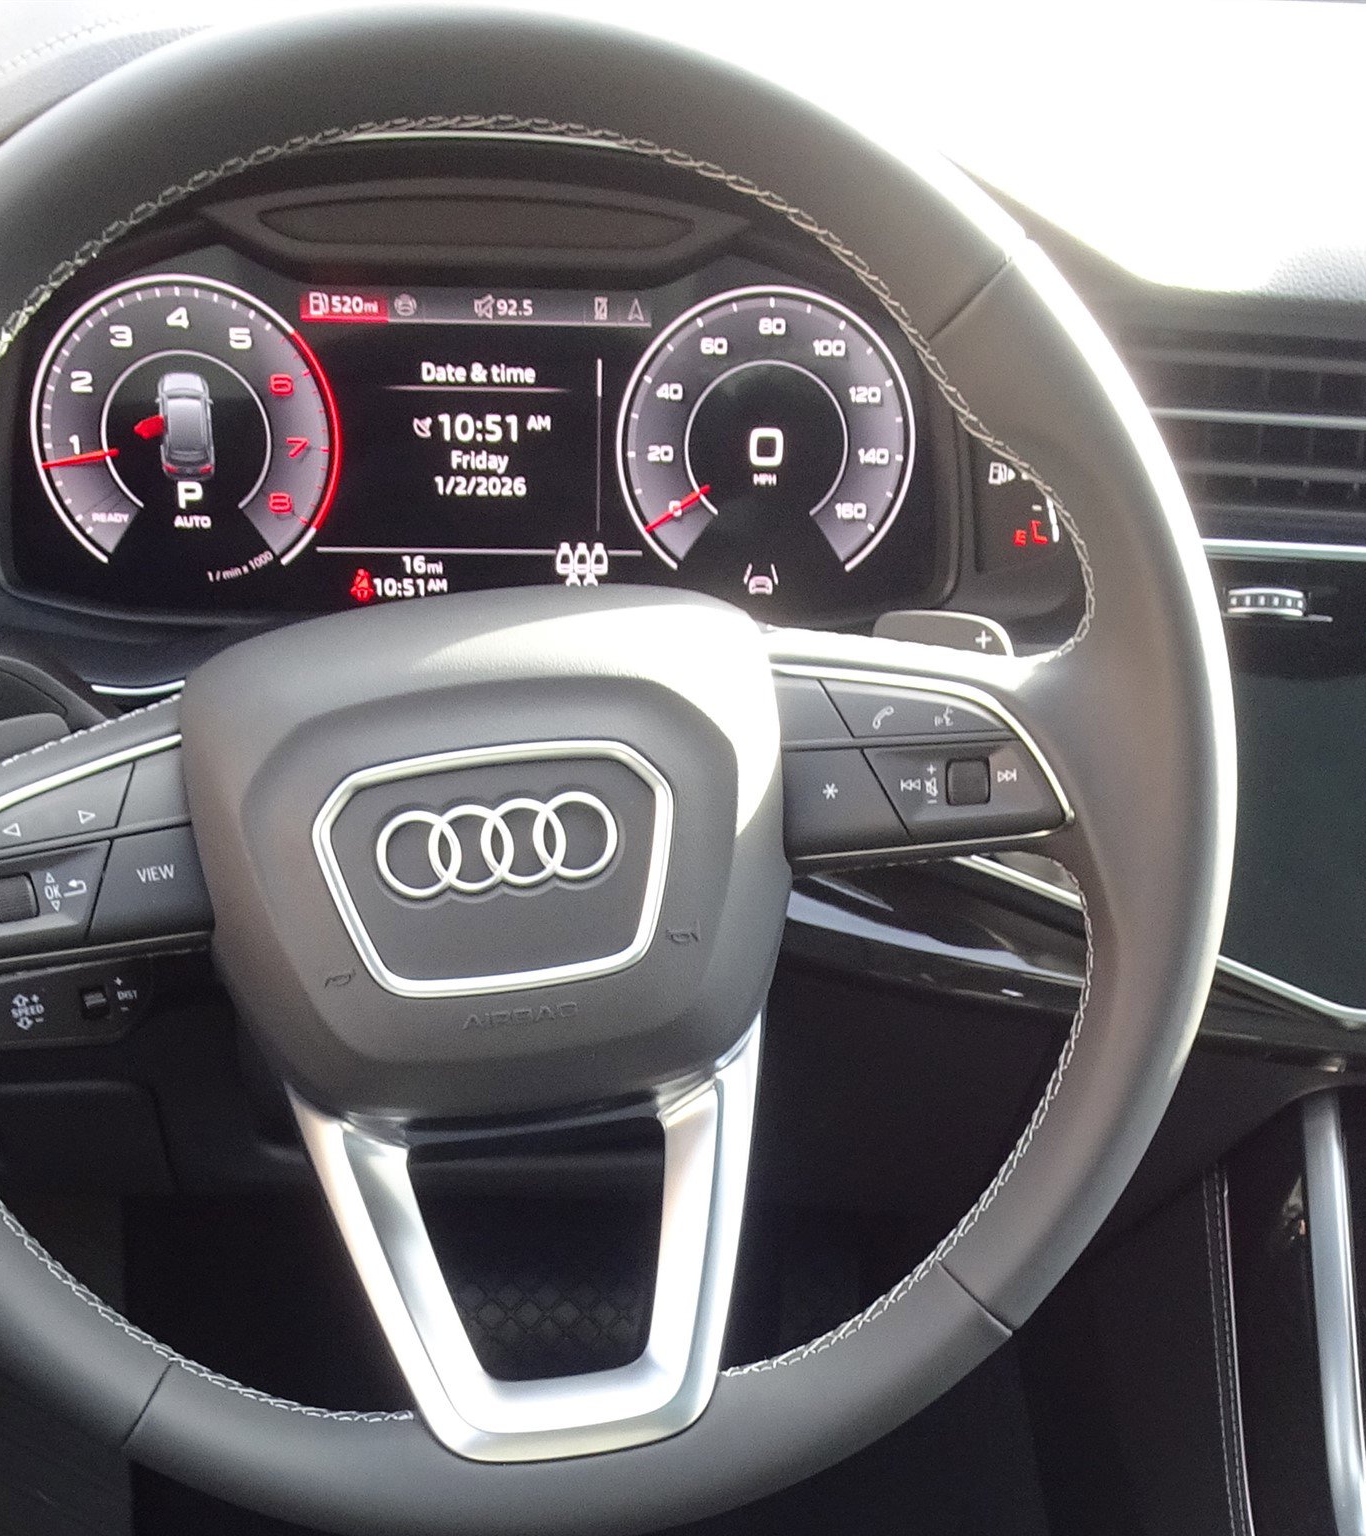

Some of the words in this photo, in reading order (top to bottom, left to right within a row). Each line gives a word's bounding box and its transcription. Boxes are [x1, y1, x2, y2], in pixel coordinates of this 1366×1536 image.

[166, 306, 190, 328] 4
[497, 300, 533, 316] 92.5
[758, 317, 787, 335] 80
[109, 325, 133, 348] 3
[229, 327, 252, 349] 5
[700, 338, 728, 355] 60
[812, 340, 846, 357] 100
[70, 371, 93, 393] 2
[421, 361, 466, 383] Date
[470, 363, 488, 382] &
[491, 363, 536, 384] time
[269, 373, 294, 396] 6
[656, 383, 683, 400] 40
[849, 387, 882, 404] 120
[438, 413, 518, 442] 10:51
[527, 415, 551, 431] AM
[69, 434, 80, 455] 1
[286, 437, 309, 458] 7
[647, 445, 675, 463] 20
[749, 427, 784, 466] 0
[451, 451, 508, 473] Friday
[857, 448, 890, 465] 140
[435, 476, 526, 497] 1/2/2026
[753, 473, 777, 485] MPH
[177, 481, 203, 508] P
[268, 492, 293, 514] 8
[91, 512, 130, 524] READY
[834, 503, 867, 520] 160
[174, 515, 212, 529] AUTO
[1014, 529, 1027, 546] E
[136, 864, 174, 884] VIEW
[44, 885, 62, 900] OK
[11, 1004, 45, 1018] SPEED
